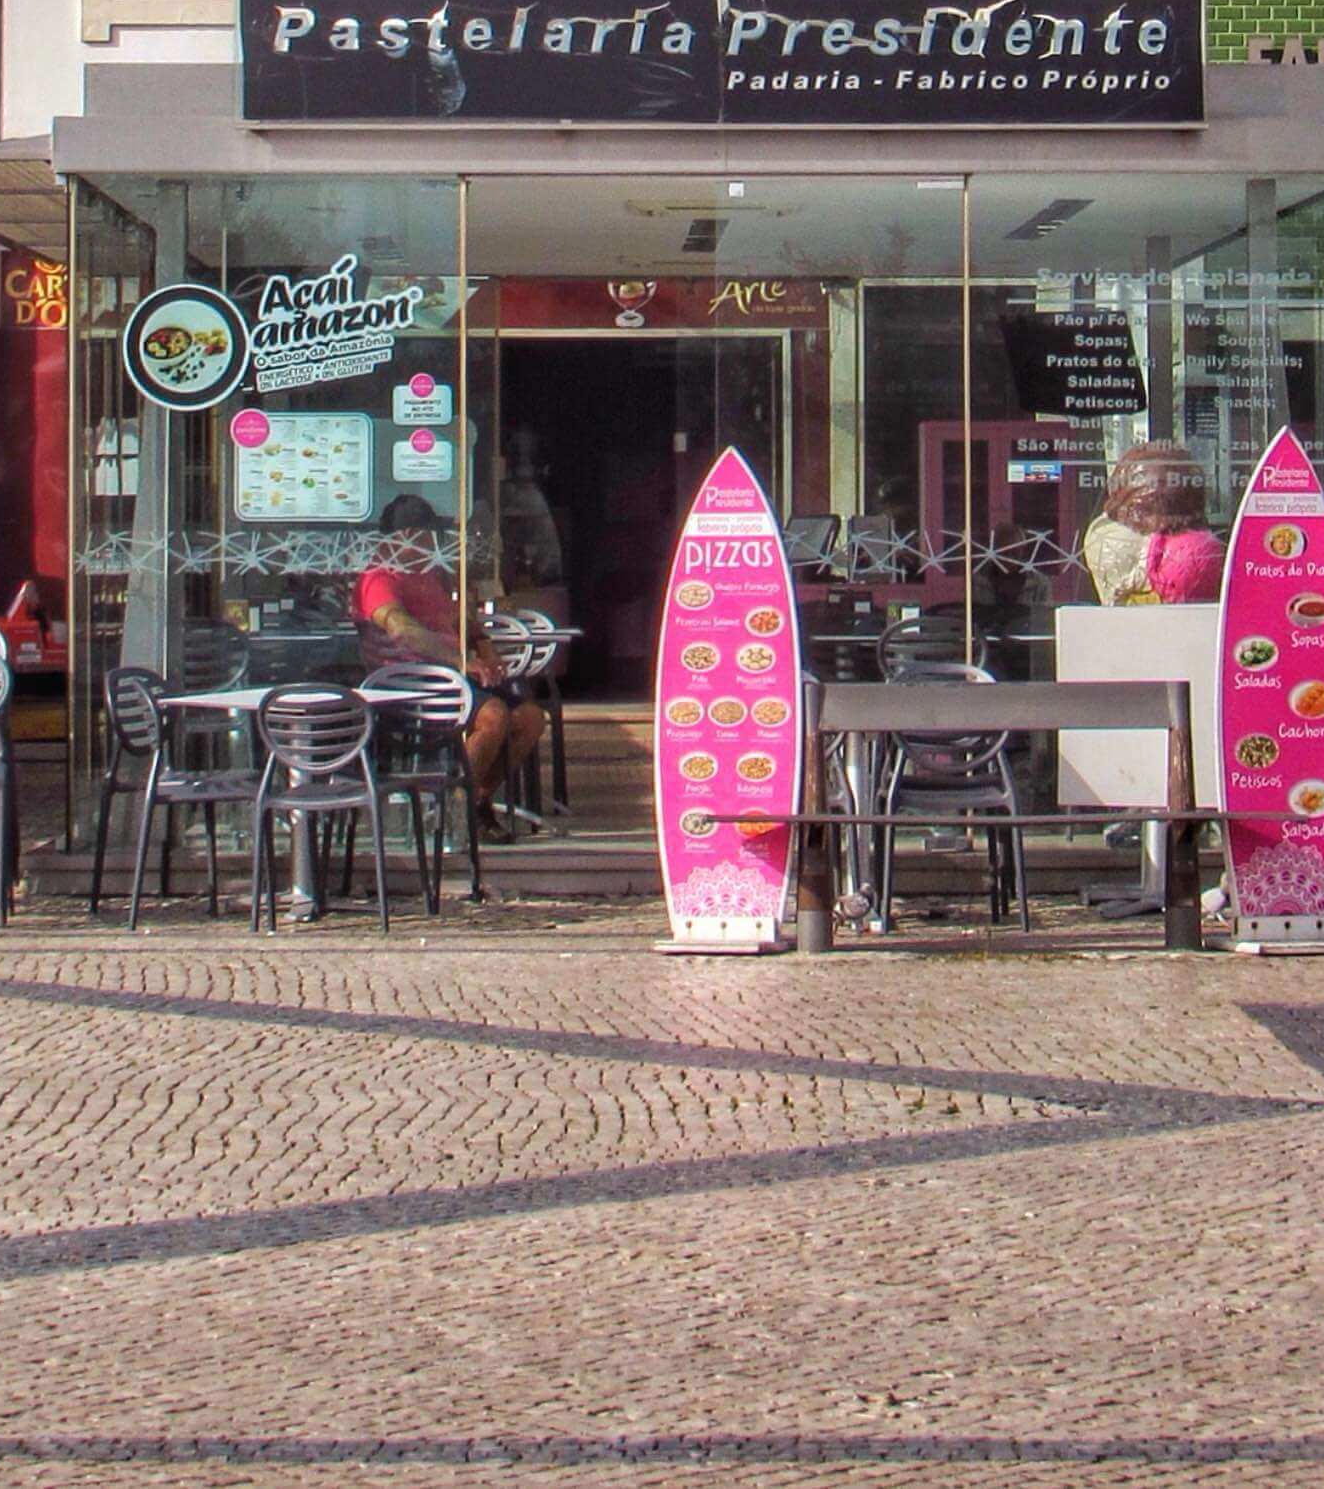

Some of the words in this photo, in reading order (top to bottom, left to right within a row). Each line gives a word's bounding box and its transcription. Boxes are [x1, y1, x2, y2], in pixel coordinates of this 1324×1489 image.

[274, 4, 695, 55] Pastelaria
[725, 4, 1170, 57] Presidente
[727, 69, 865, 91] Padaria
[896, 69, 1029, 91] Fabrico
[1041, 67, 1172, 95] Próprio
[261, 255, 356, 321] Açaí
[252, 296, 411, 350] amazon
[1054, 313, 1085, 326] Pão
[256, 356, 267, 367] O
[270, 347, 307, 365] sabor
[309, 344, 326, 358] da
[329, 334, 392, 355] Amazônia
[1074, 334, 1128, 350] Sopas;
[1046, 354, 1098, 368] Pratos
[1103, 354, 1123, 368] do
[1067, 374, 1136, 390] Saladas;
[1064, 395, 1139, 410] Petiscos;
[1016, 436, 1049, 453] São
[685, 540, 774, 575] pizzas
[1244, 562, 1285, 578] Pratos
[1286, 562, 1304, 577] do
[1234, 673, 1282, 690] Saladas
[1231, 772, 1283, 788] Petiscos
